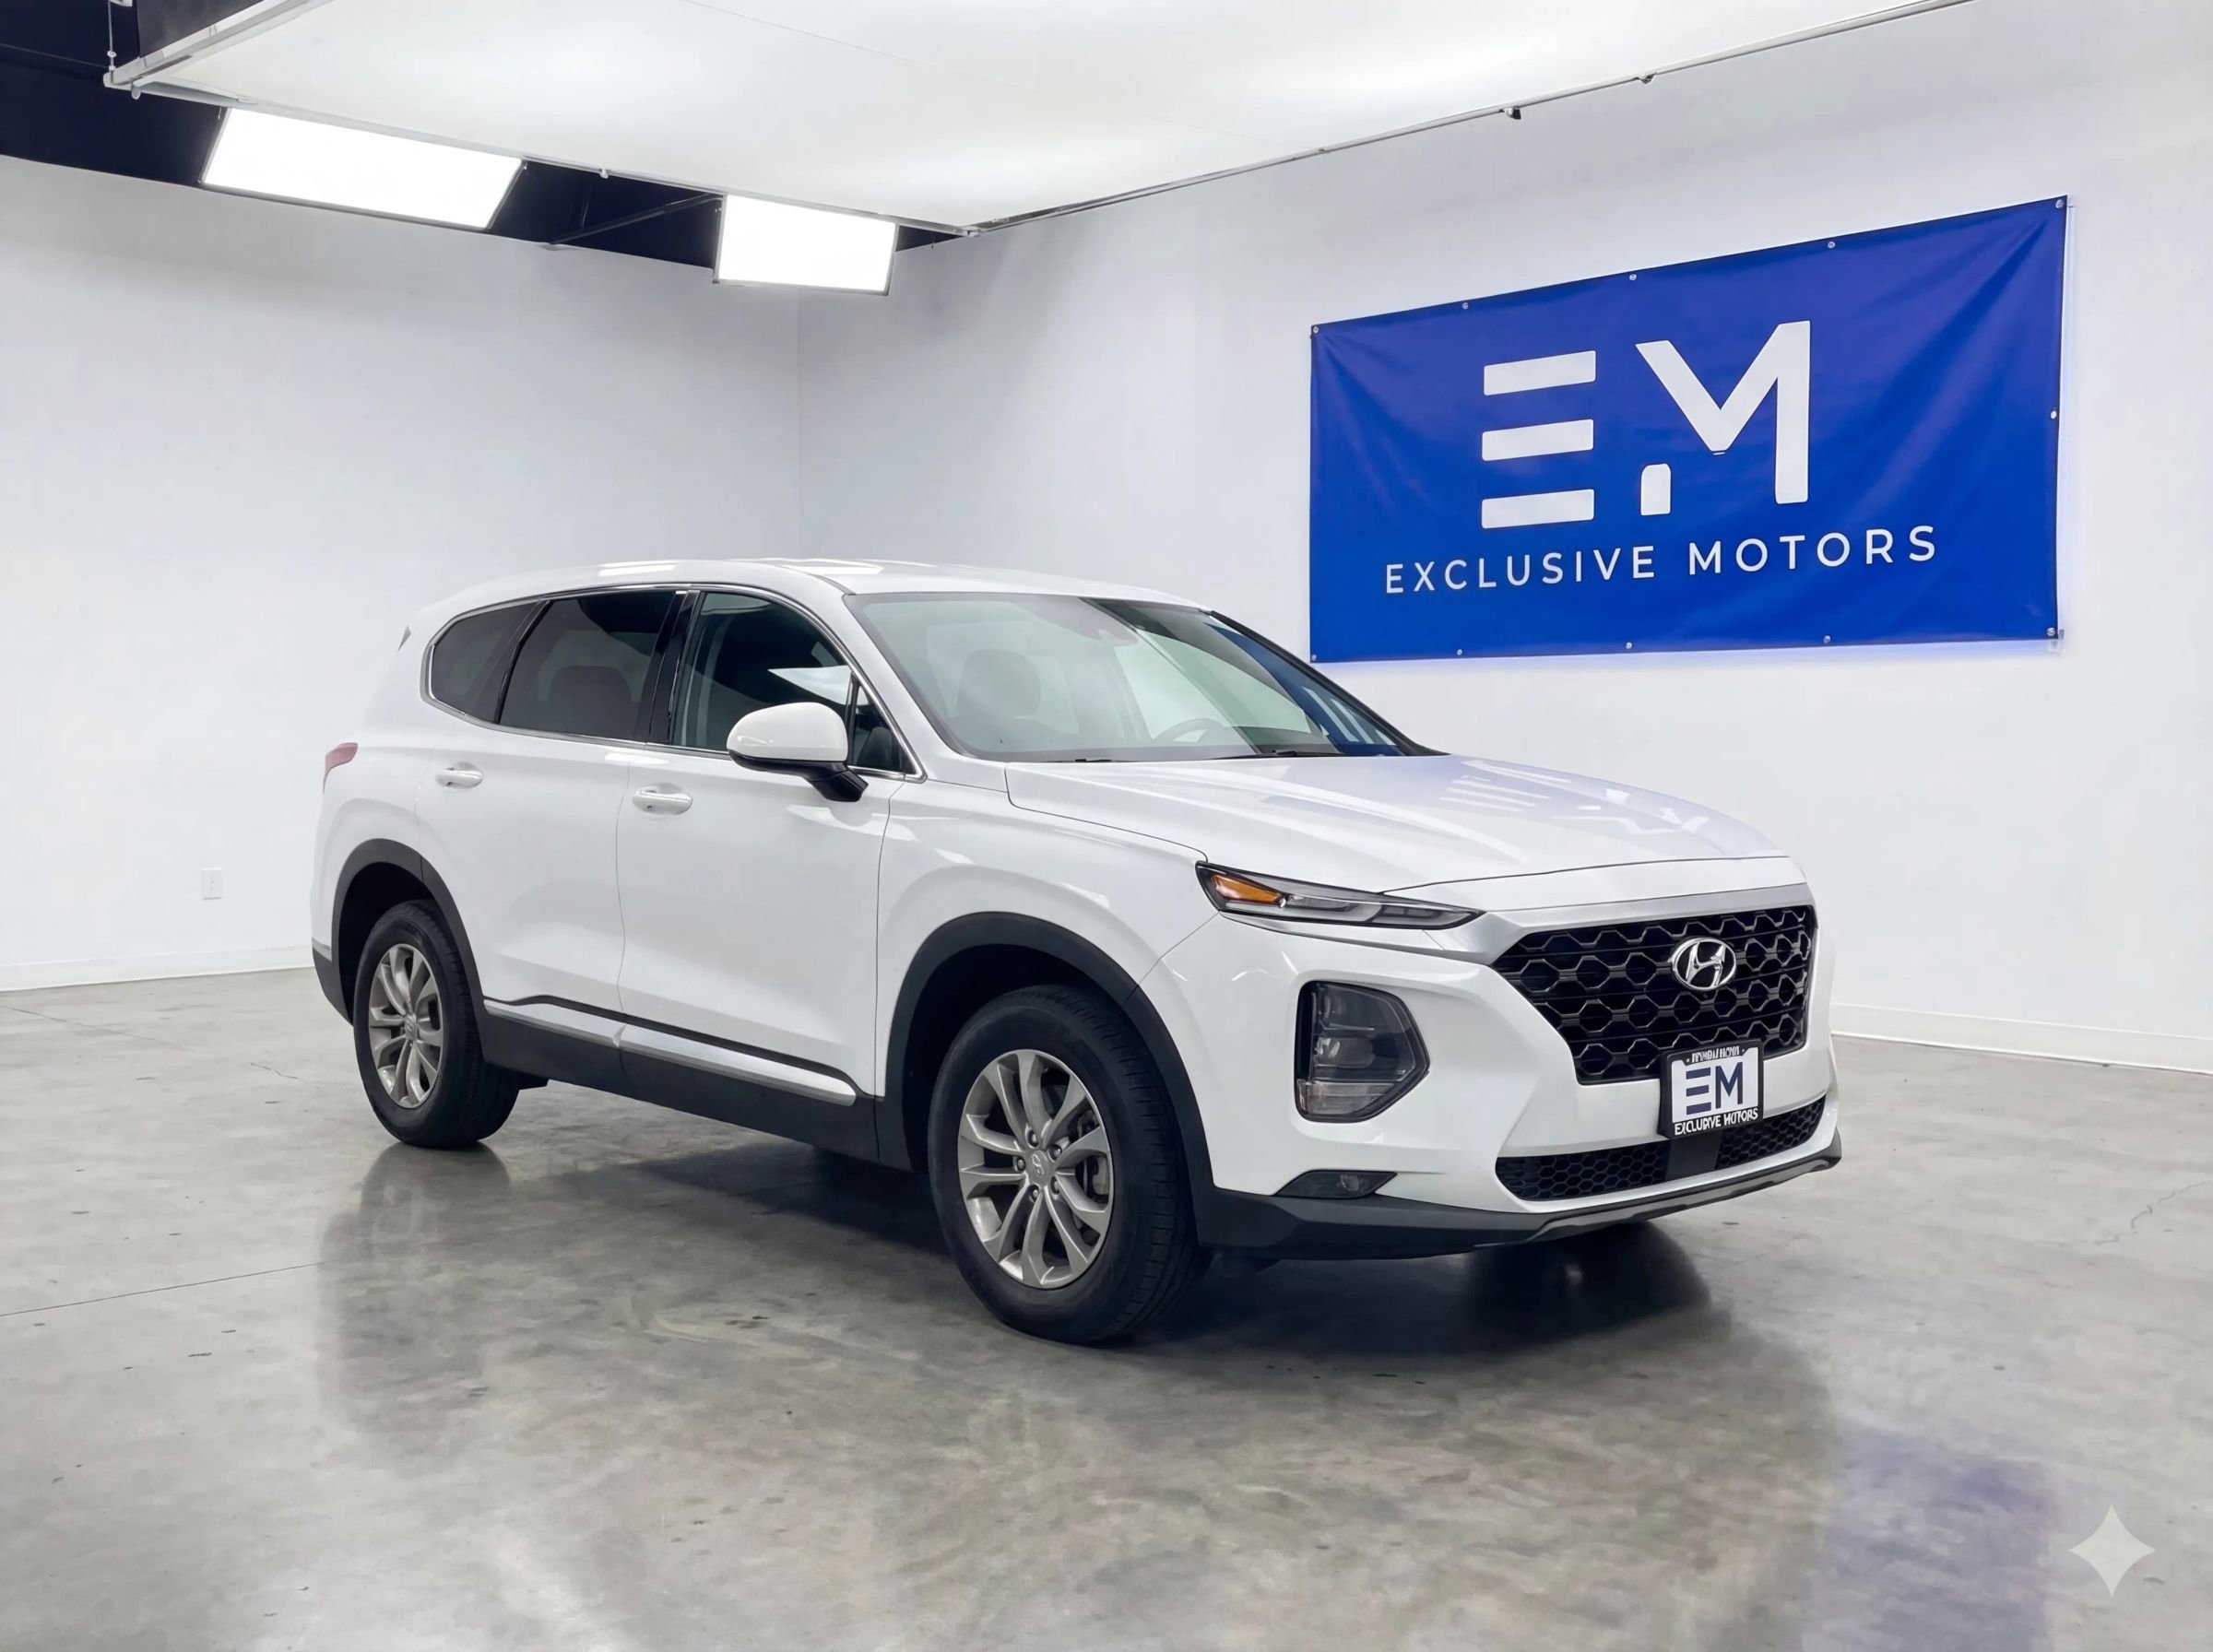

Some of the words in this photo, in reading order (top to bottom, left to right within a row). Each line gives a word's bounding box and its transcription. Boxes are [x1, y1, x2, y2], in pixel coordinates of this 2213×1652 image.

[1481, 320, 1811, 530] EM
[1386, 546, 1655, 595] EXCLUSIVE
[1688, 525, 1935, 576] MOTORS
[1686, 1061, 1743, 1115] EM
